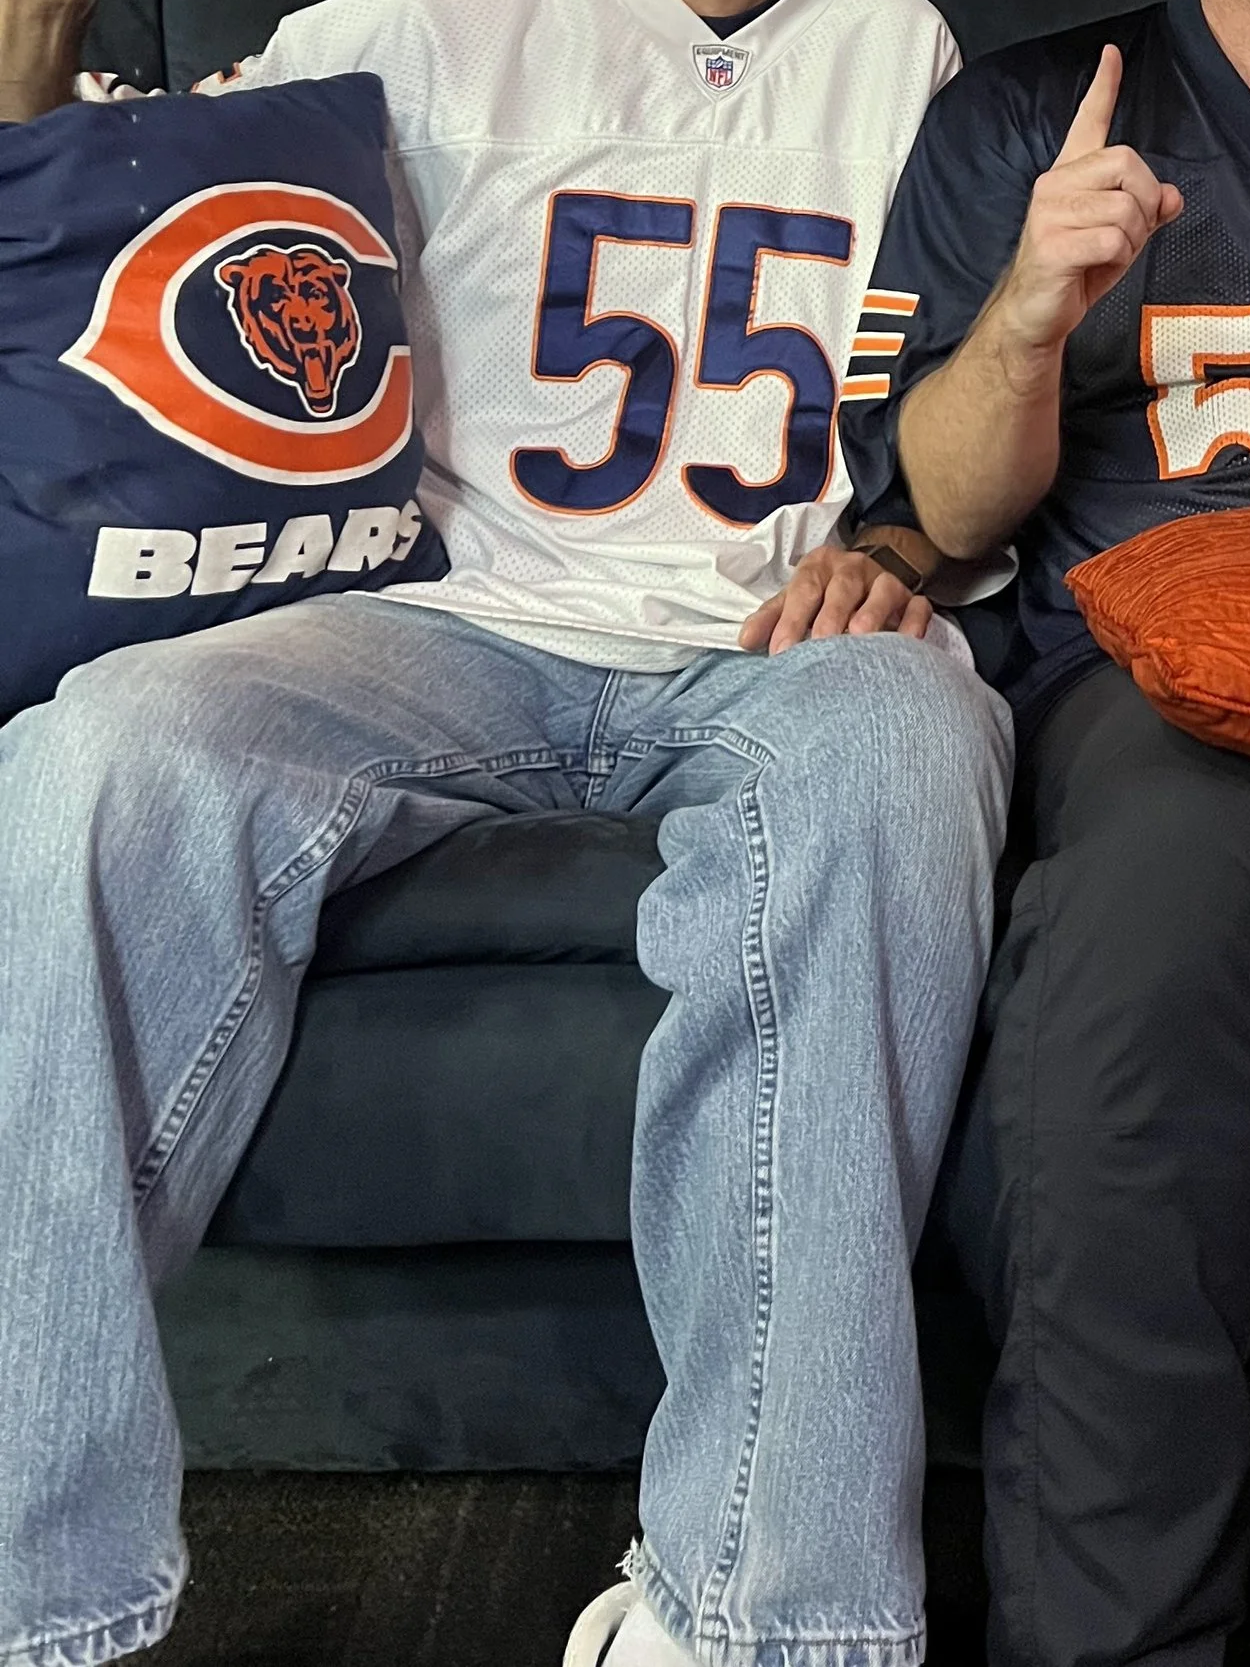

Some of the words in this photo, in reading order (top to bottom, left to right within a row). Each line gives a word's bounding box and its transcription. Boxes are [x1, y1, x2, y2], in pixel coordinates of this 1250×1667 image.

[708, 66, 733, 85] NFL
[509, 189, 857, 531] 55
[88, 498, 424, 598] BEARS
